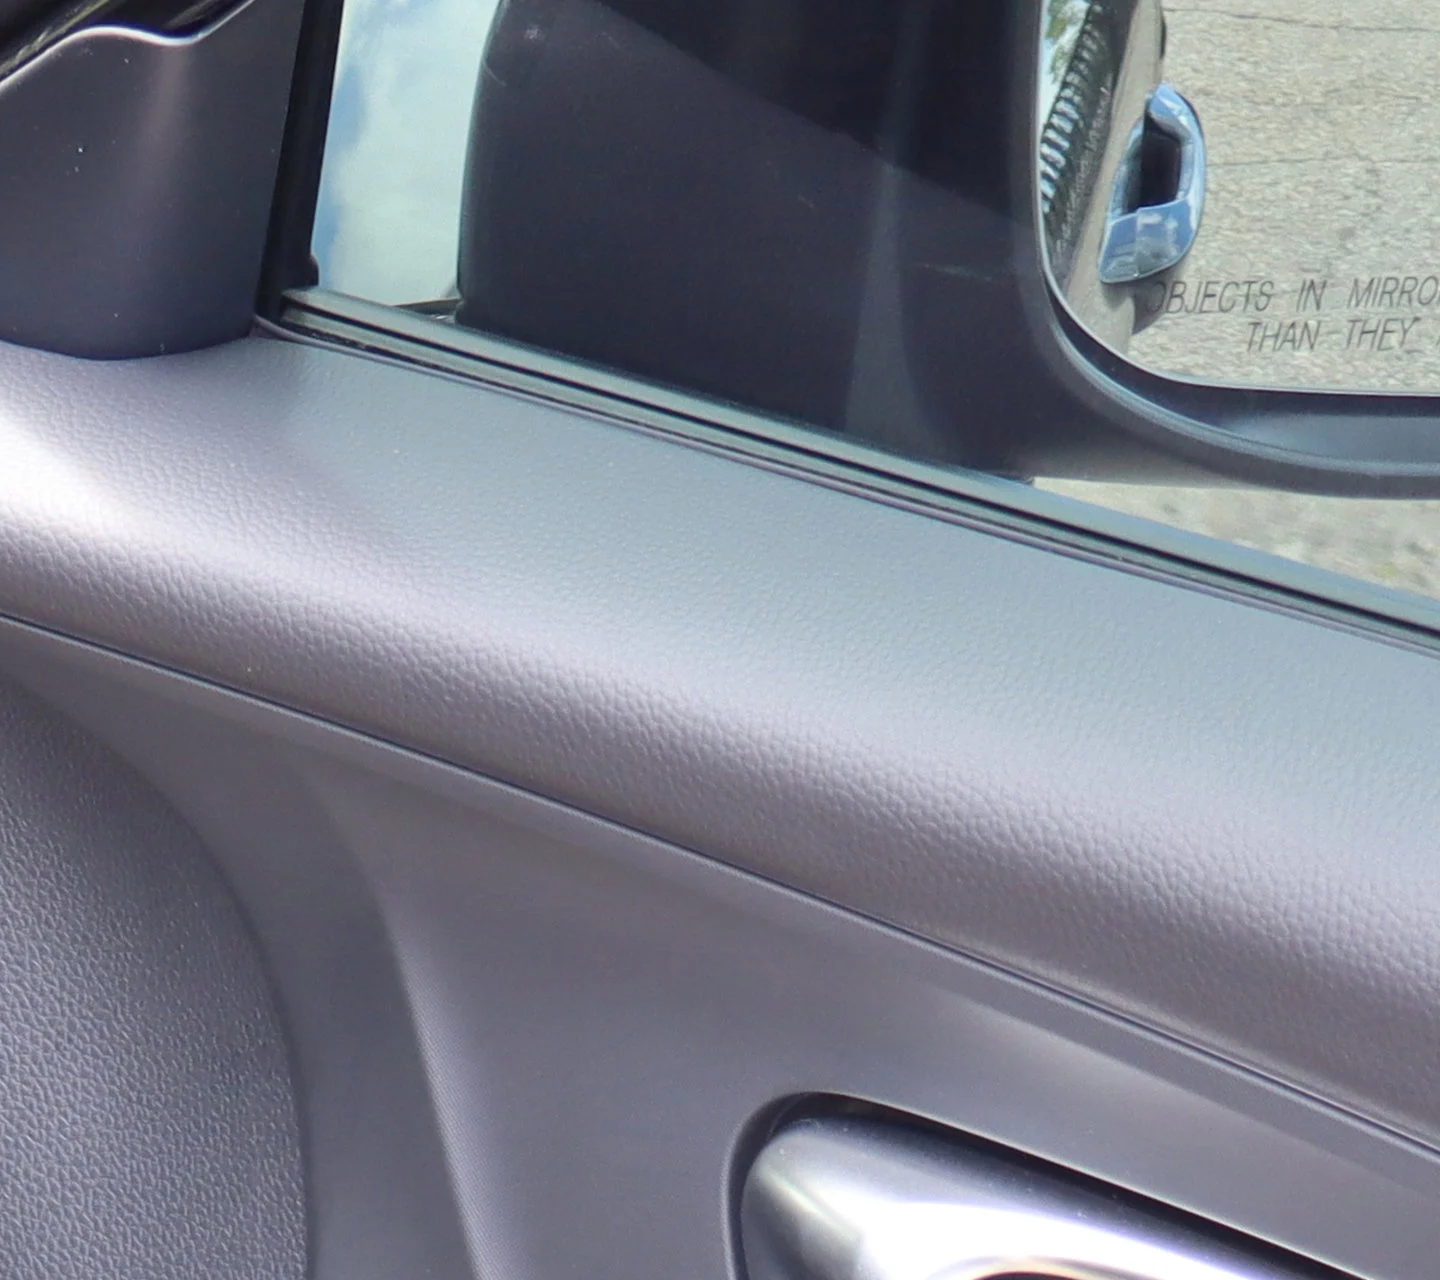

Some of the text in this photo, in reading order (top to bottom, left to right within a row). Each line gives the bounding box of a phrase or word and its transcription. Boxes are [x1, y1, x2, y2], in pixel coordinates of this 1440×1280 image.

[1145, 275, 1440, 314] OBJECTS IN MIRRO
[1246, 315, 1422, 352] THAN THEY
